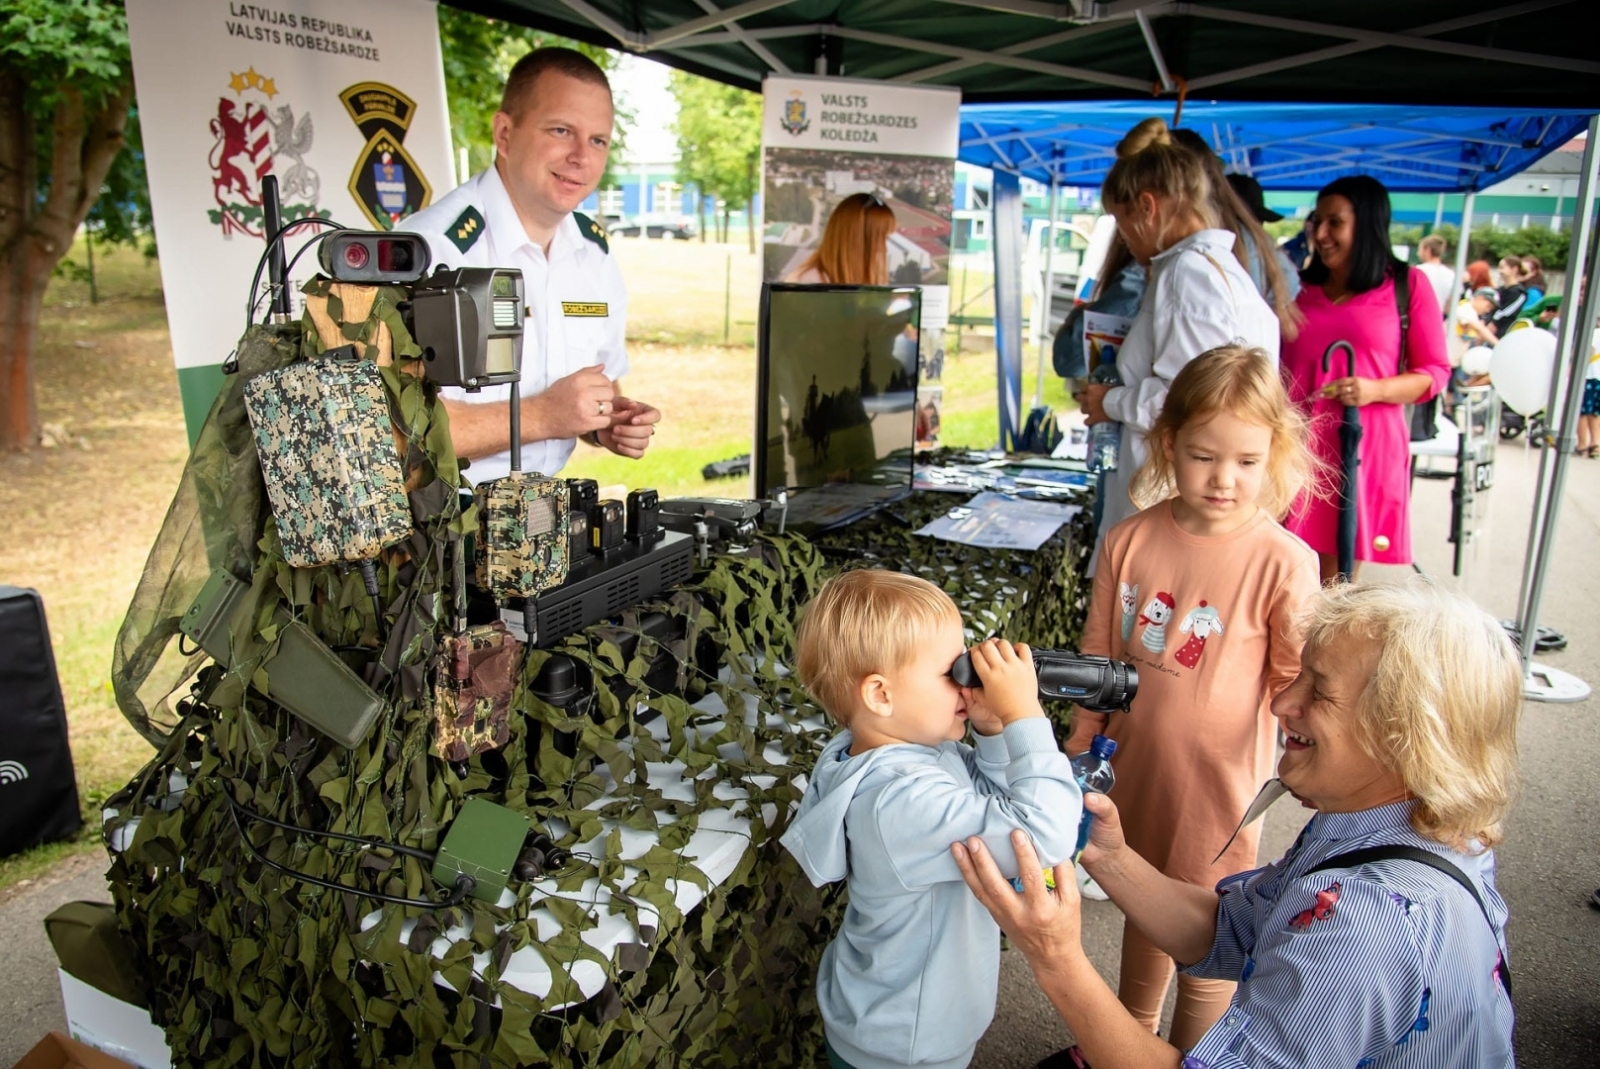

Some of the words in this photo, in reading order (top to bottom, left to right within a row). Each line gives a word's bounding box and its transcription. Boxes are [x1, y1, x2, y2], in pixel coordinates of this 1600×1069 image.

[230, 2, 298, 28] LATVIJAS
[300, 16, 374, 43] REPUBLIKA
[225, 20, 281, 45] VALSTS
[285, 32, 380, 61] ROBEŽSARDZE
[820, 94, 868, 109] VALSTS
[820, 111, 918, 129] ROBEŽSARDZES
[820, 128, 878, 143] KOLEDŽA
